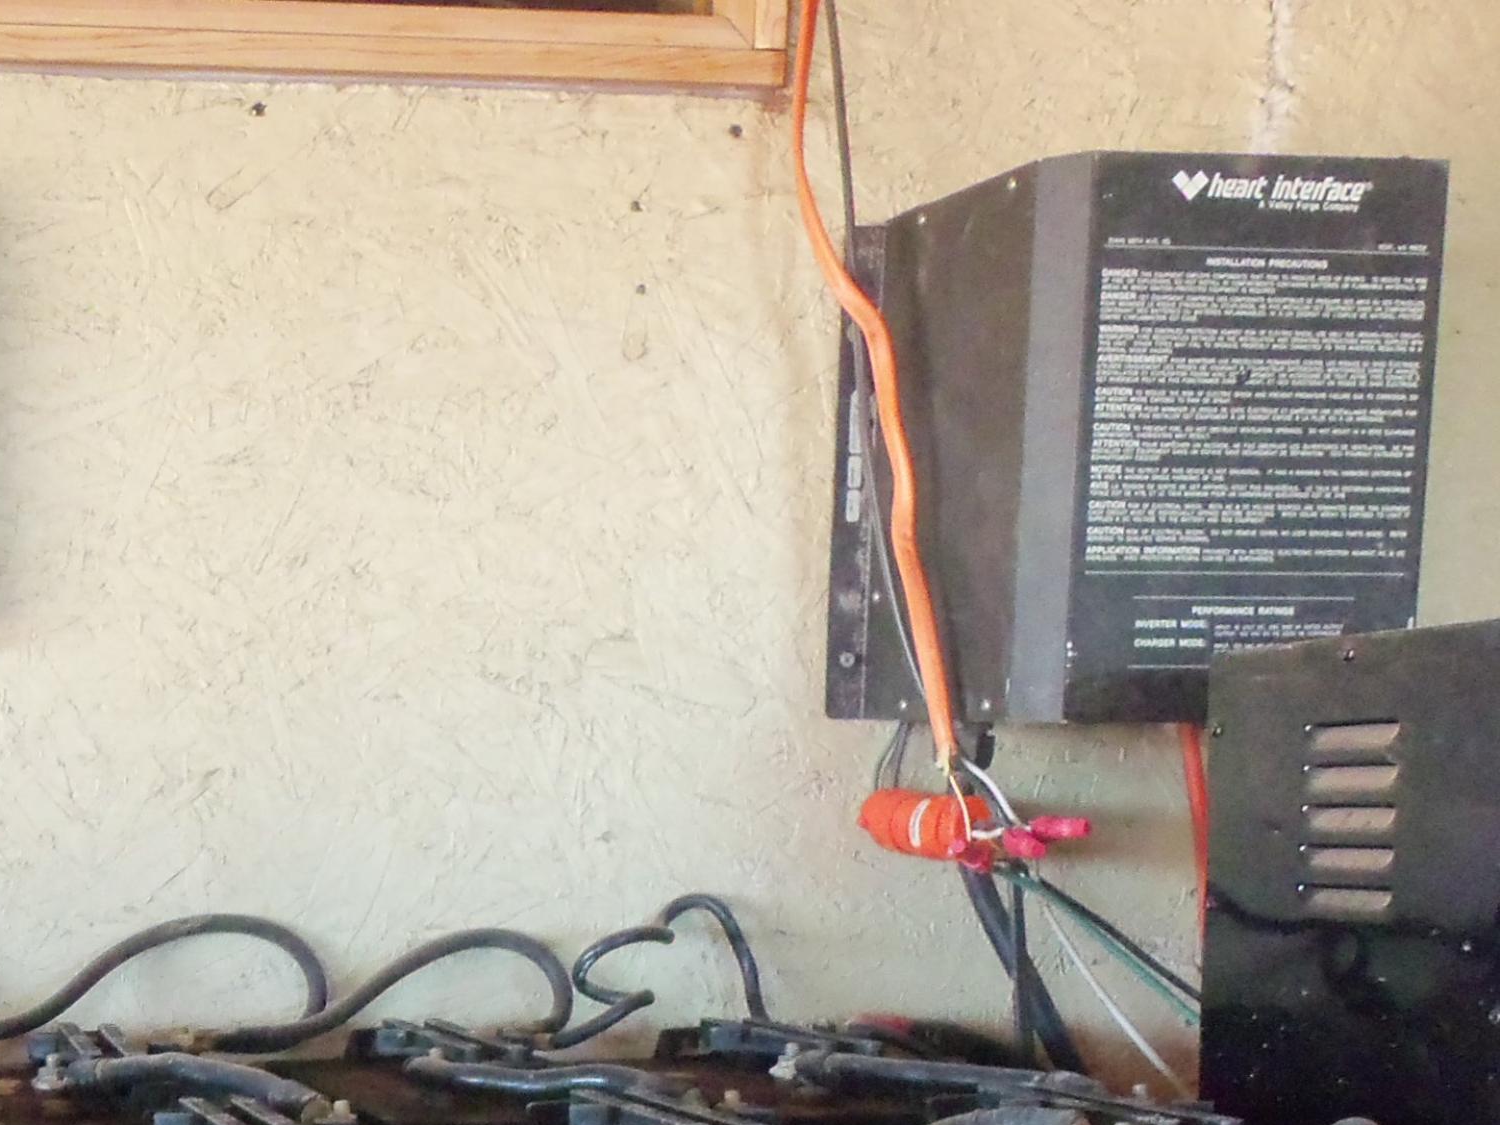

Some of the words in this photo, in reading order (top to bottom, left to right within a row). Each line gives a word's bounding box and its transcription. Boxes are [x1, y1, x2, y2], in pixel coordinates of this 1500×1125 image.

[1207, 172, 1269, 200] heart
[1270, 174, 1366, 202] interface
[1322, 202, 1360, 213] Company
[1205, 256, 1266, 268] INSTALLATION
[1268, 258, 1329, 271] PRECAUTIONS
[1094, 386, 1133, 396] CAUTION
[1092, 422, 1131, 432] CAUTION
[1191, 606, 1255, 616] PERFORMANCE
[1257, 606, 1295, 616] RATINGS
[1135, 619, 1177, 629] INVERTER
[1133, 638, 1175, 648] CHARGER
